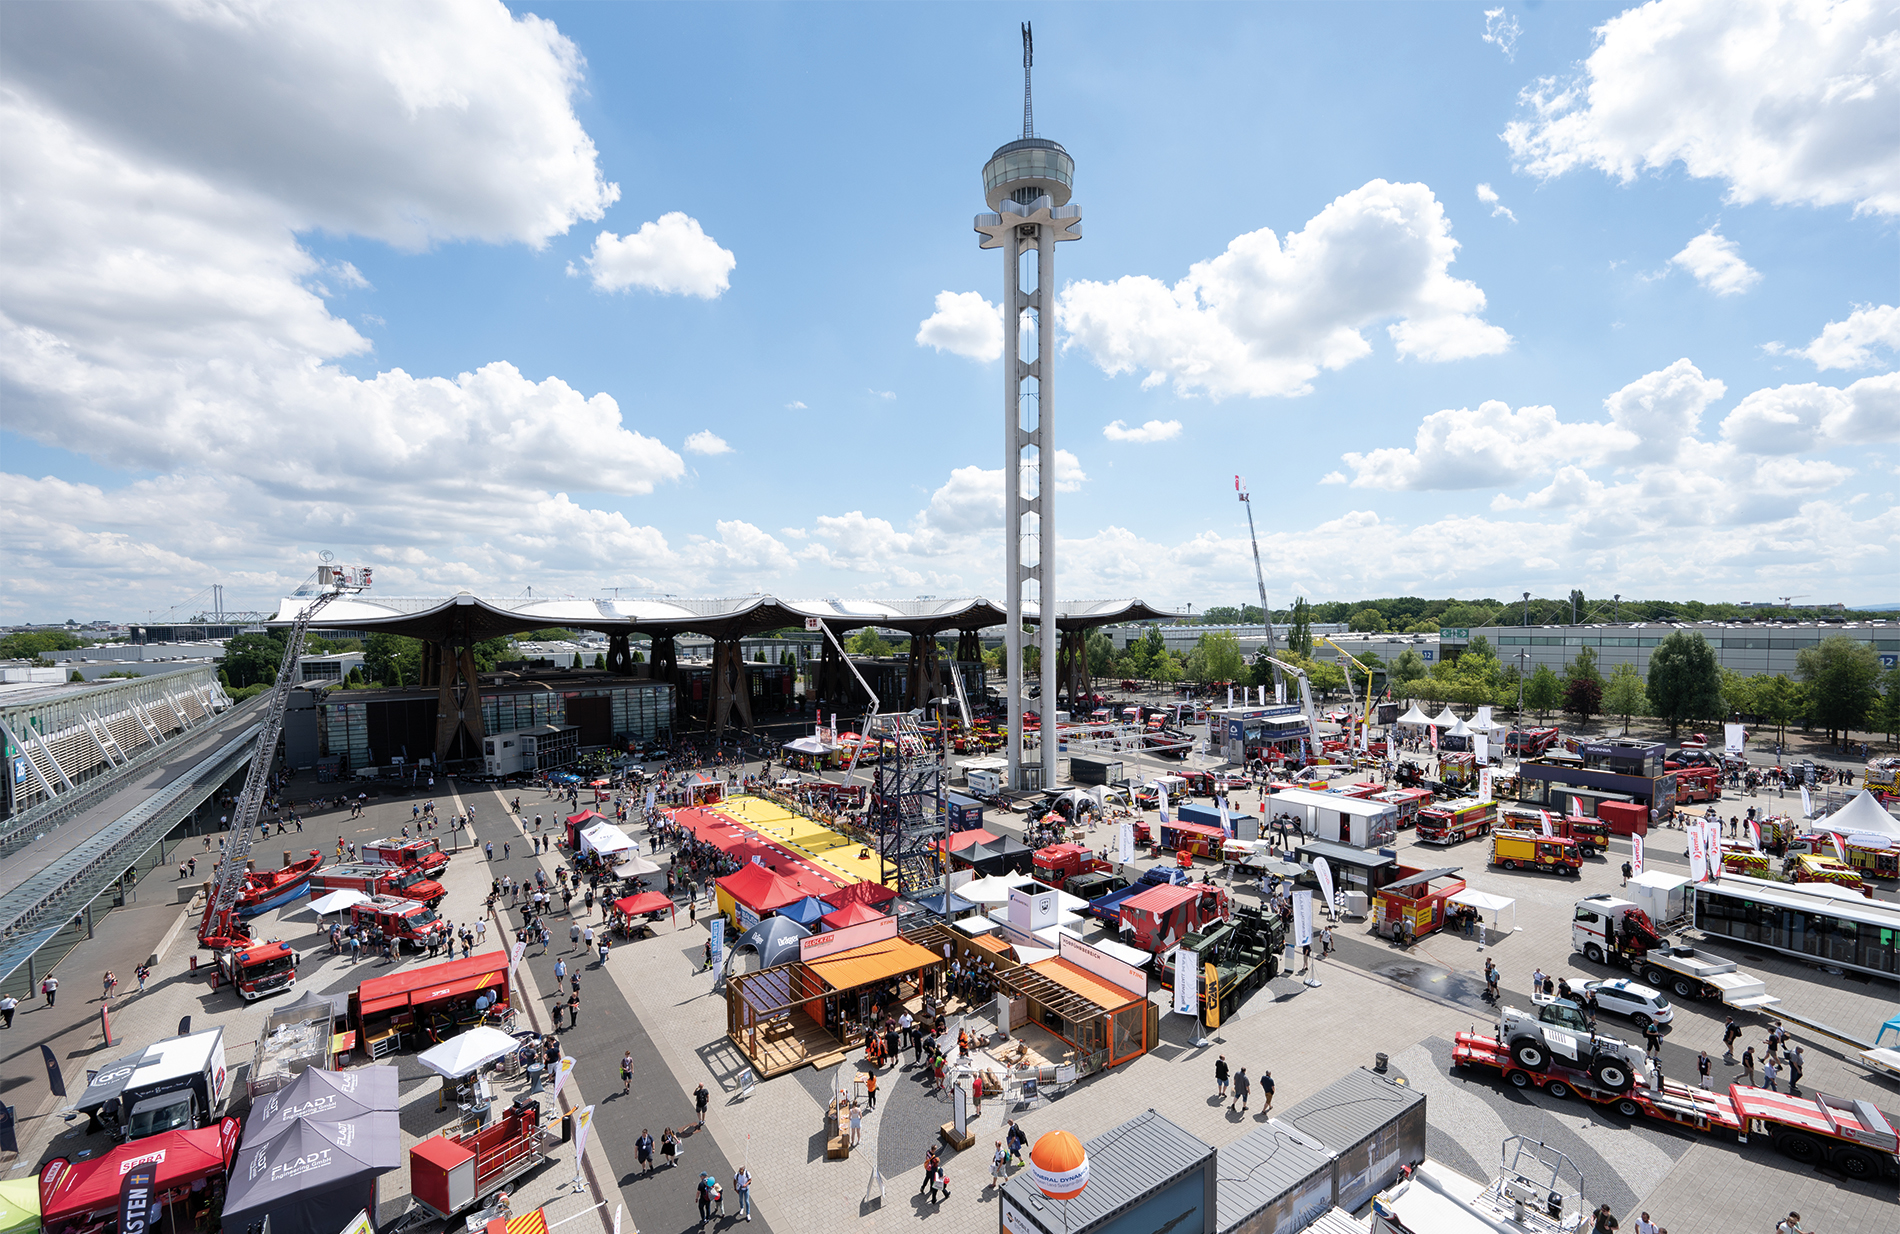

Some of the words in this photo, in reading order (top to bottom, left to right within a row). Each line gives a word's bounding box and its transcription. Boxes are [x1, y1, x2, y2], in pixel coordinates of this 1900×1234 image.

[1880, 657, 1893, 666] 12
[16, 761, 25, 778] 26
[880, 919, 894, 927] STIHL
[777, 935, 799, 947] Dräger
[804, 935, 834, 948] GLOCKZIN
[283, 1094, 336, 1117] FLADT
[283, 1106, 318, 1121] Engineering
[318, 1102, 337, 1111] GmbH
[271, 1164, 310, 1182] Engineering
[311, 1157, 332, 1169] GmbH
[272, 1149, 331, 1176] FLADT
